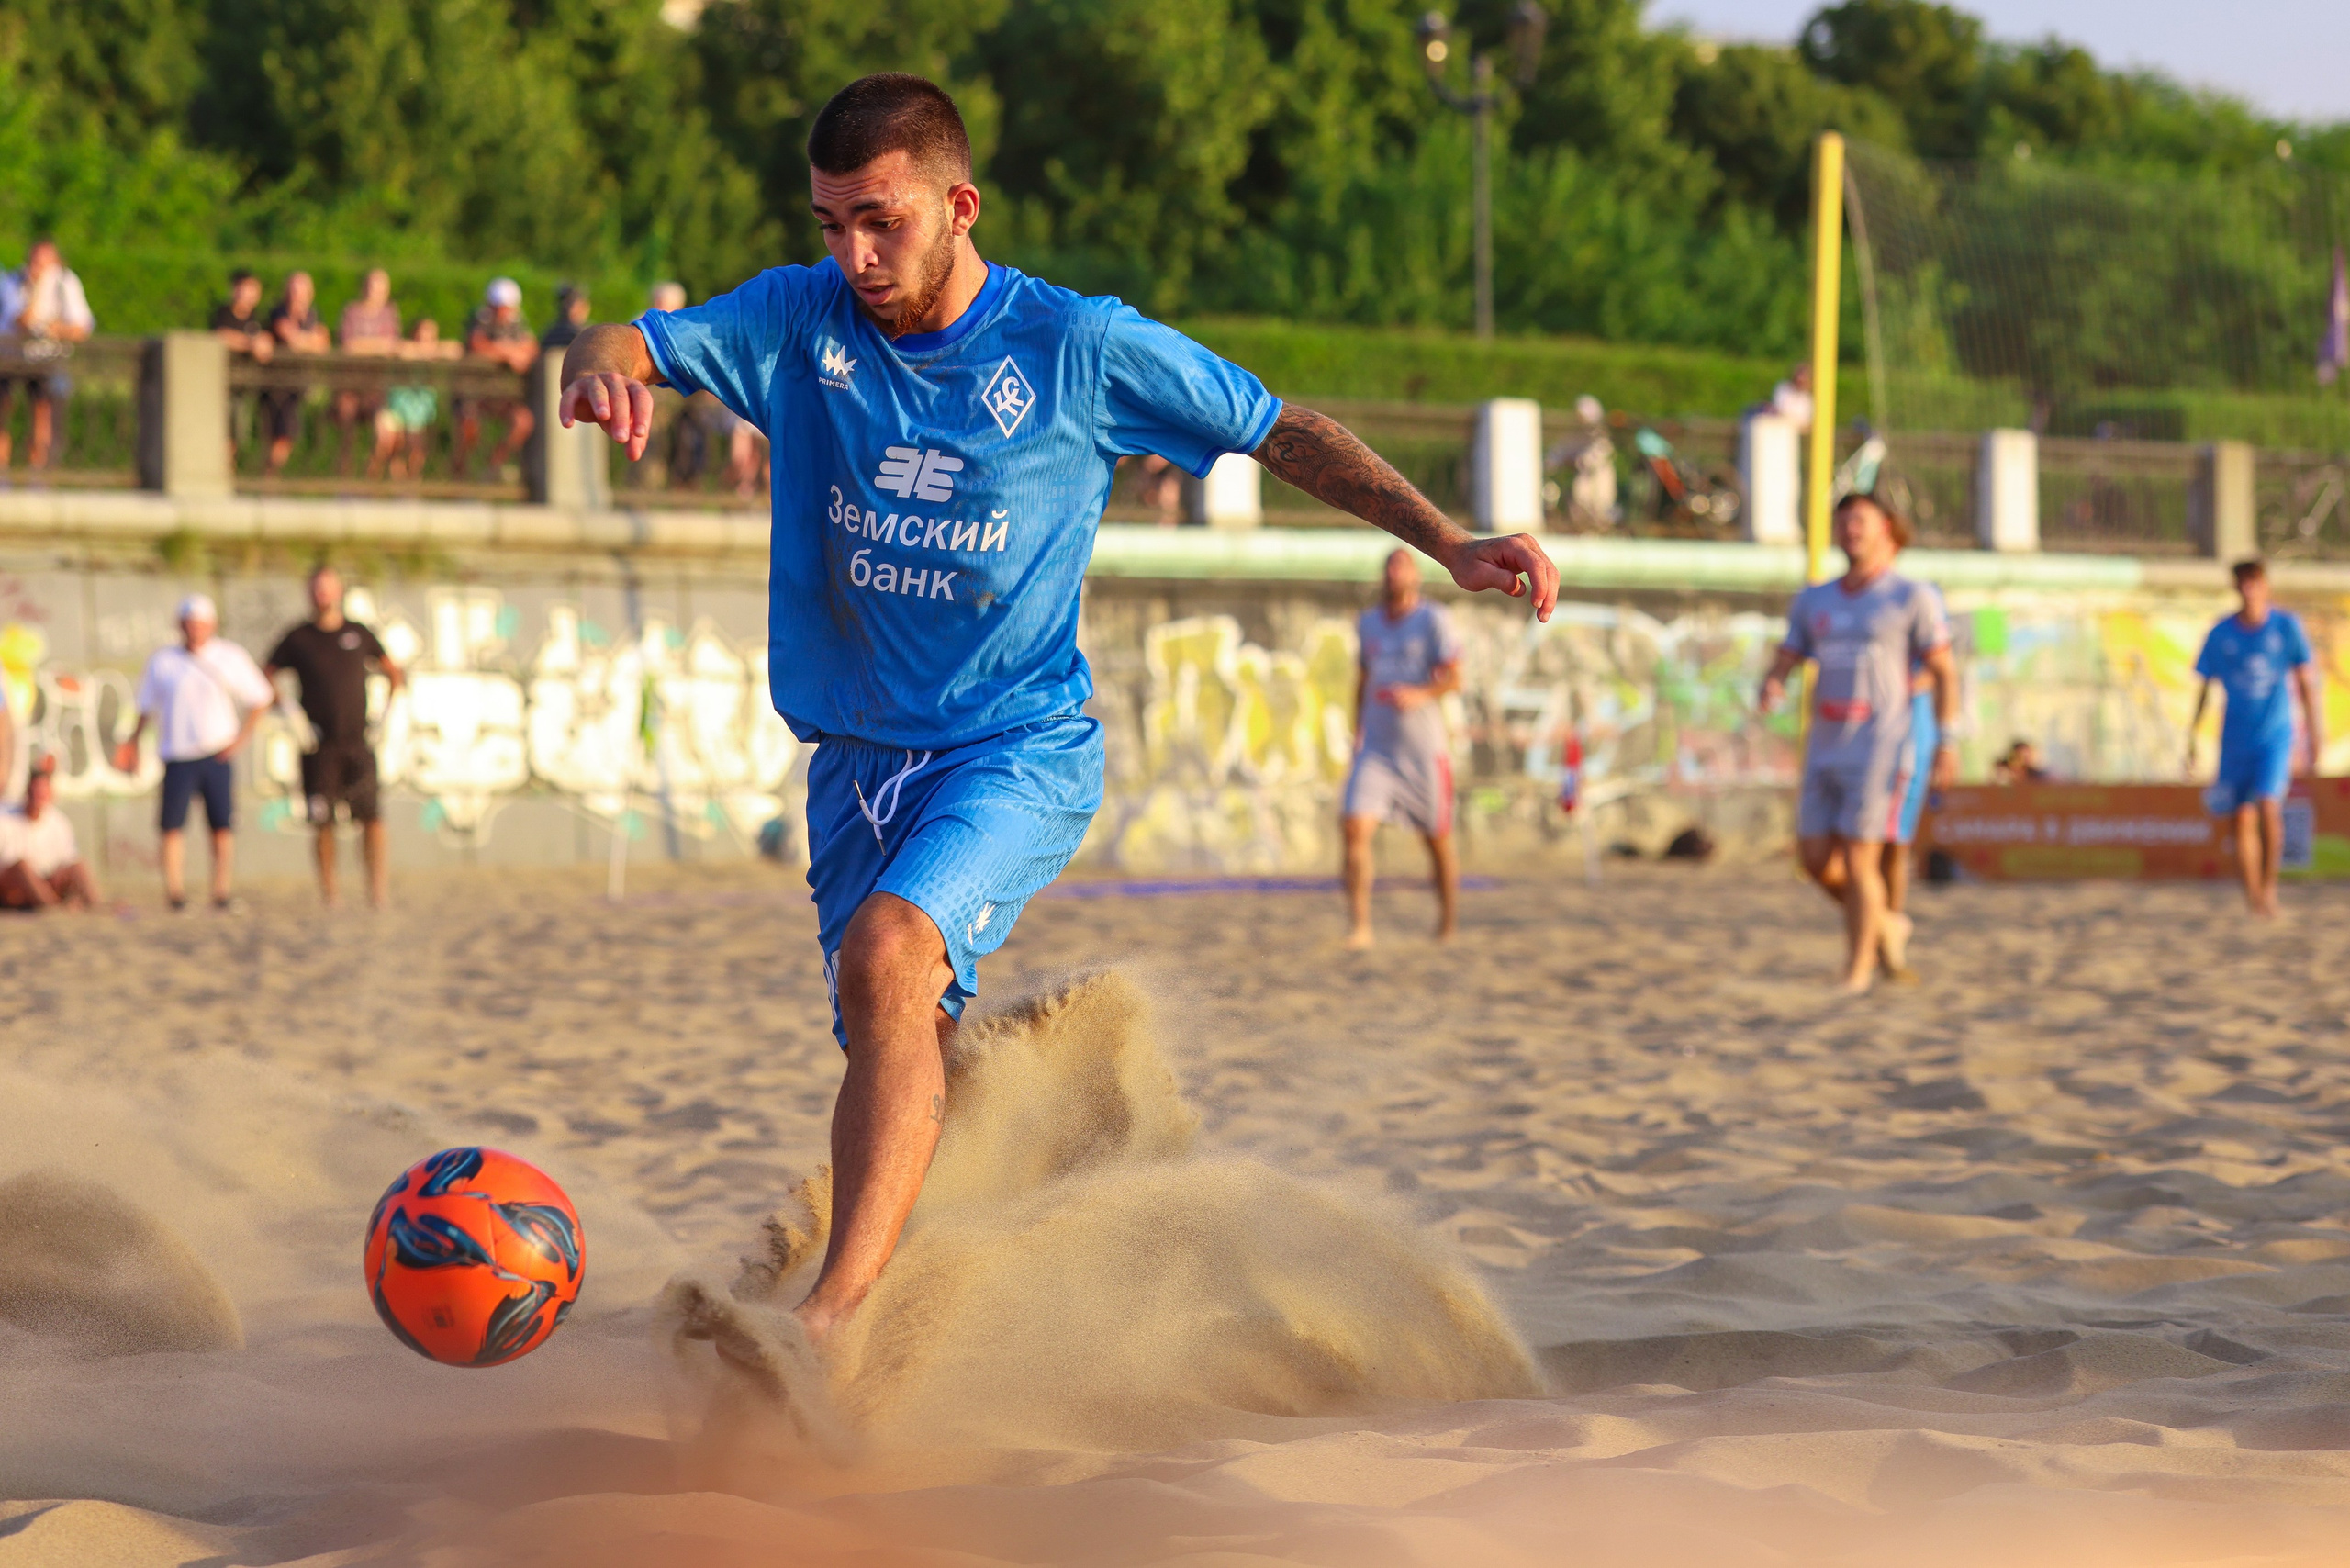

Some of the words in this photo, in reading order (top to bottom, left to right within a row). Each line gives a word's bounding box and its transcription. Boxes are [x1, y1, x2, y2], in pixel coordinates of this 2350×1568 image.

[818, 376, 849, 391] PRIMERA
[828, 485, 1010, 552] Земский
[849, 548, 958, 601] банк
